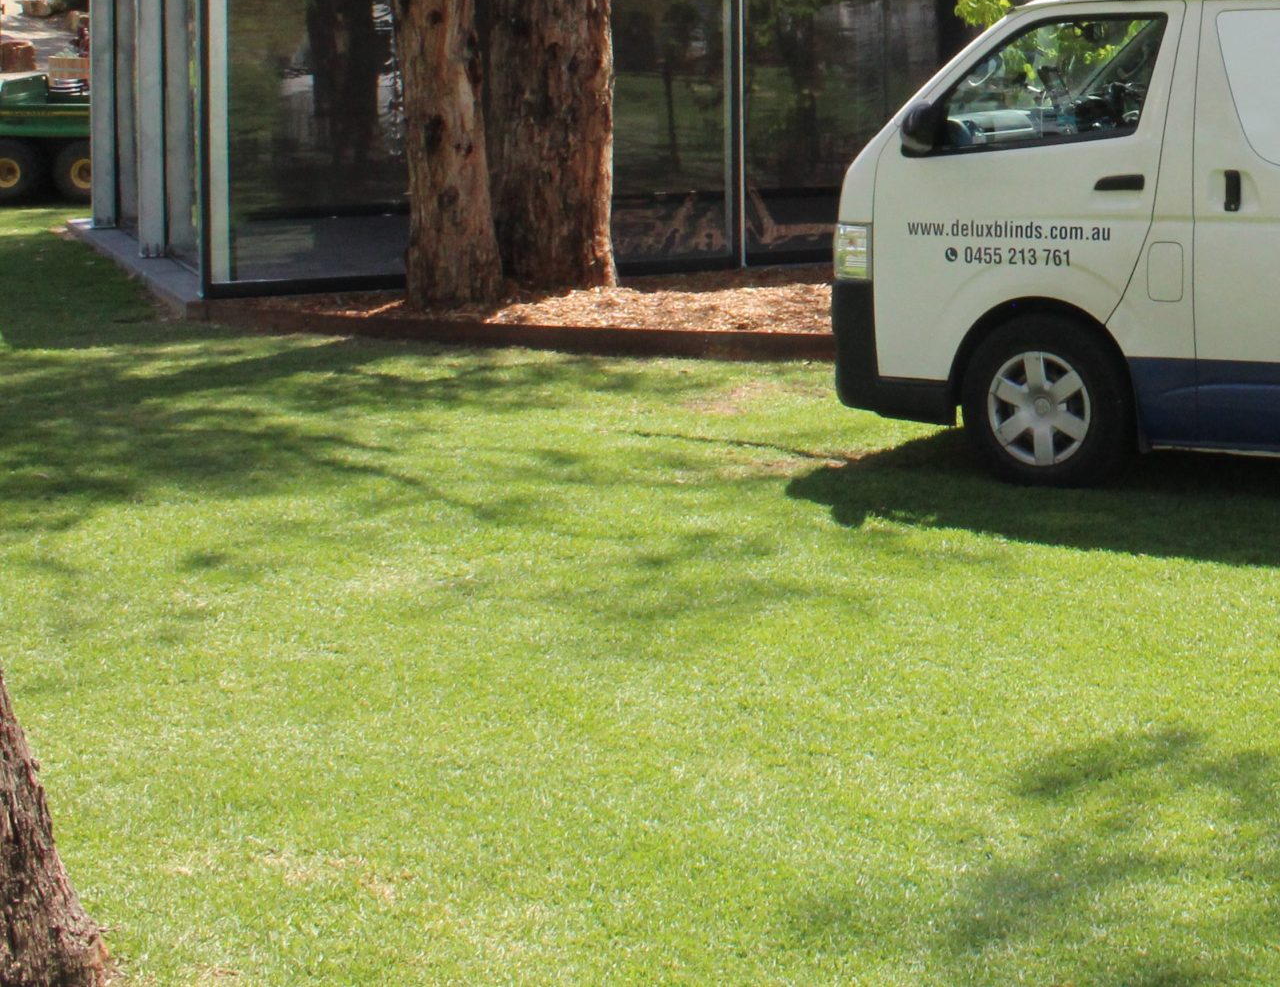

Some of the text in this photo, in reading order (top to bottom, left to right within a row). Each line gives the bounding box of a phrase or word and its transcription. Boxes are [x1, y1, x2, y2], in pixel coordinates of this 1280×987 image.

[907, 219, 1112, 242] www.deluxblinds.com.au
[964, 246, 1071, 267] 0455 213 761
